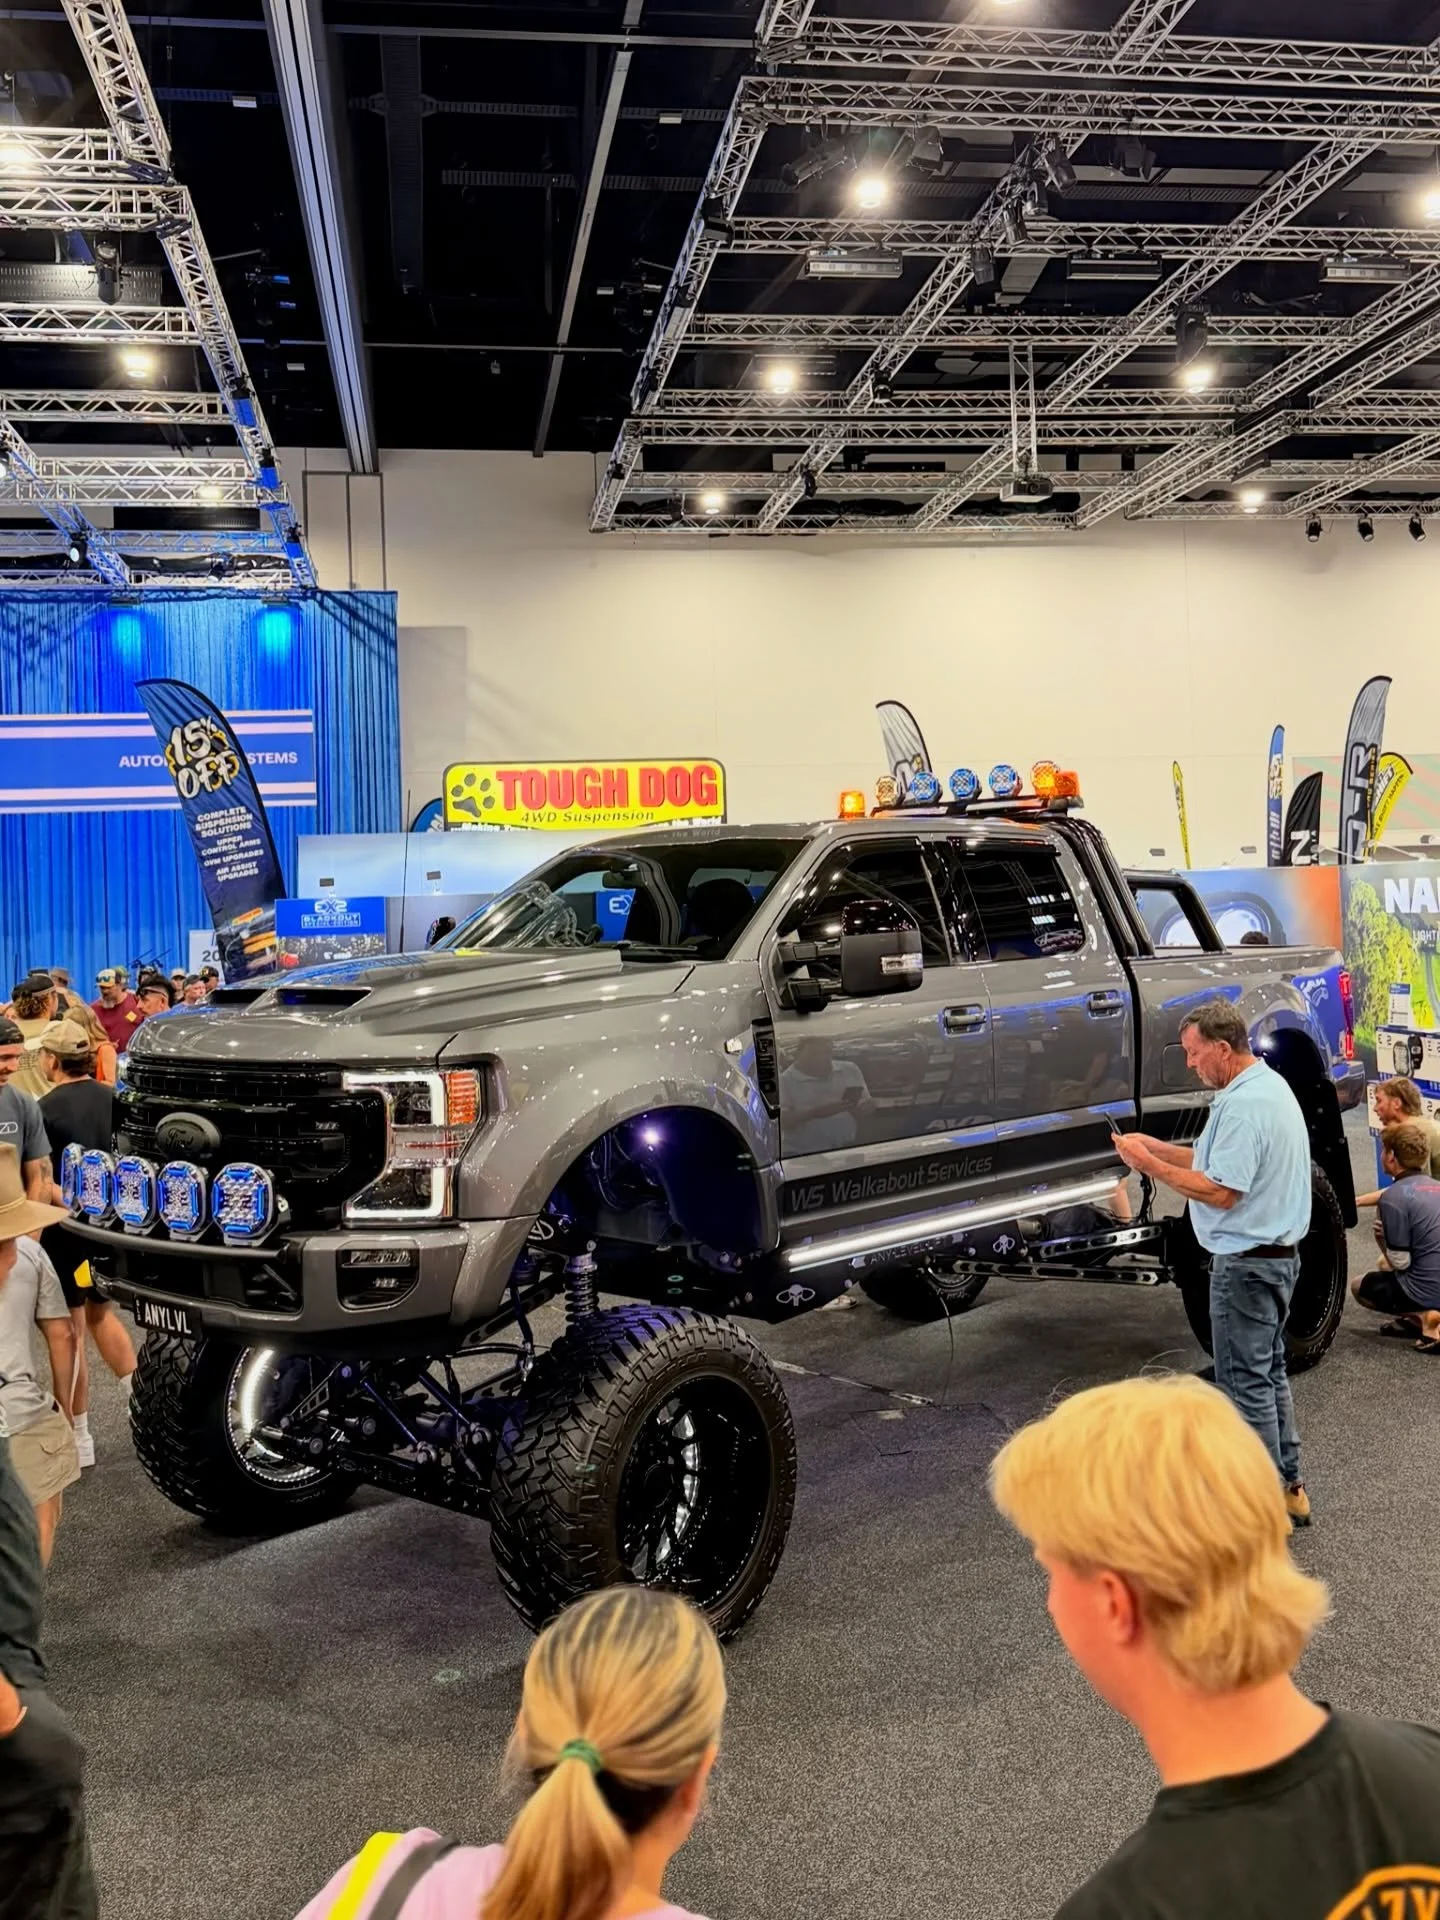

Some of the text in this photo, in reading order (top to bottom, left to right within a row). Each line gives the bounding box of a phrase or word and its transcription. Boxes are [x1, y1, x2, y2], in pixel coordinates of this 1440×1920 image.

[119, 752, 298, 768] AUTO STEMS
[178, 751, 237, 798] OFF
[496, 764, 718, 811] TOUGH DOG
[195, 813, 253, 831] SUSPENSION
[197, 806, 247, 822] COMPLETE
[521, 810, 655, 824] 4WD Suspension
[201, 821, 252, 838] SOLUTIONS
[201, 838, 262, 857] CONTROL ARMS
[216, 835, 243, 846] UPPER
[222, 849, 264, 863] UPGRADES
[216, 861, 257, 876] AIR ASSIST
[217, 868, 259, 883] UPGRADES
[792, 1156, 993, 1211] WS Walkabout Services
[145, 1302, 192, 1335] ANYLVL
